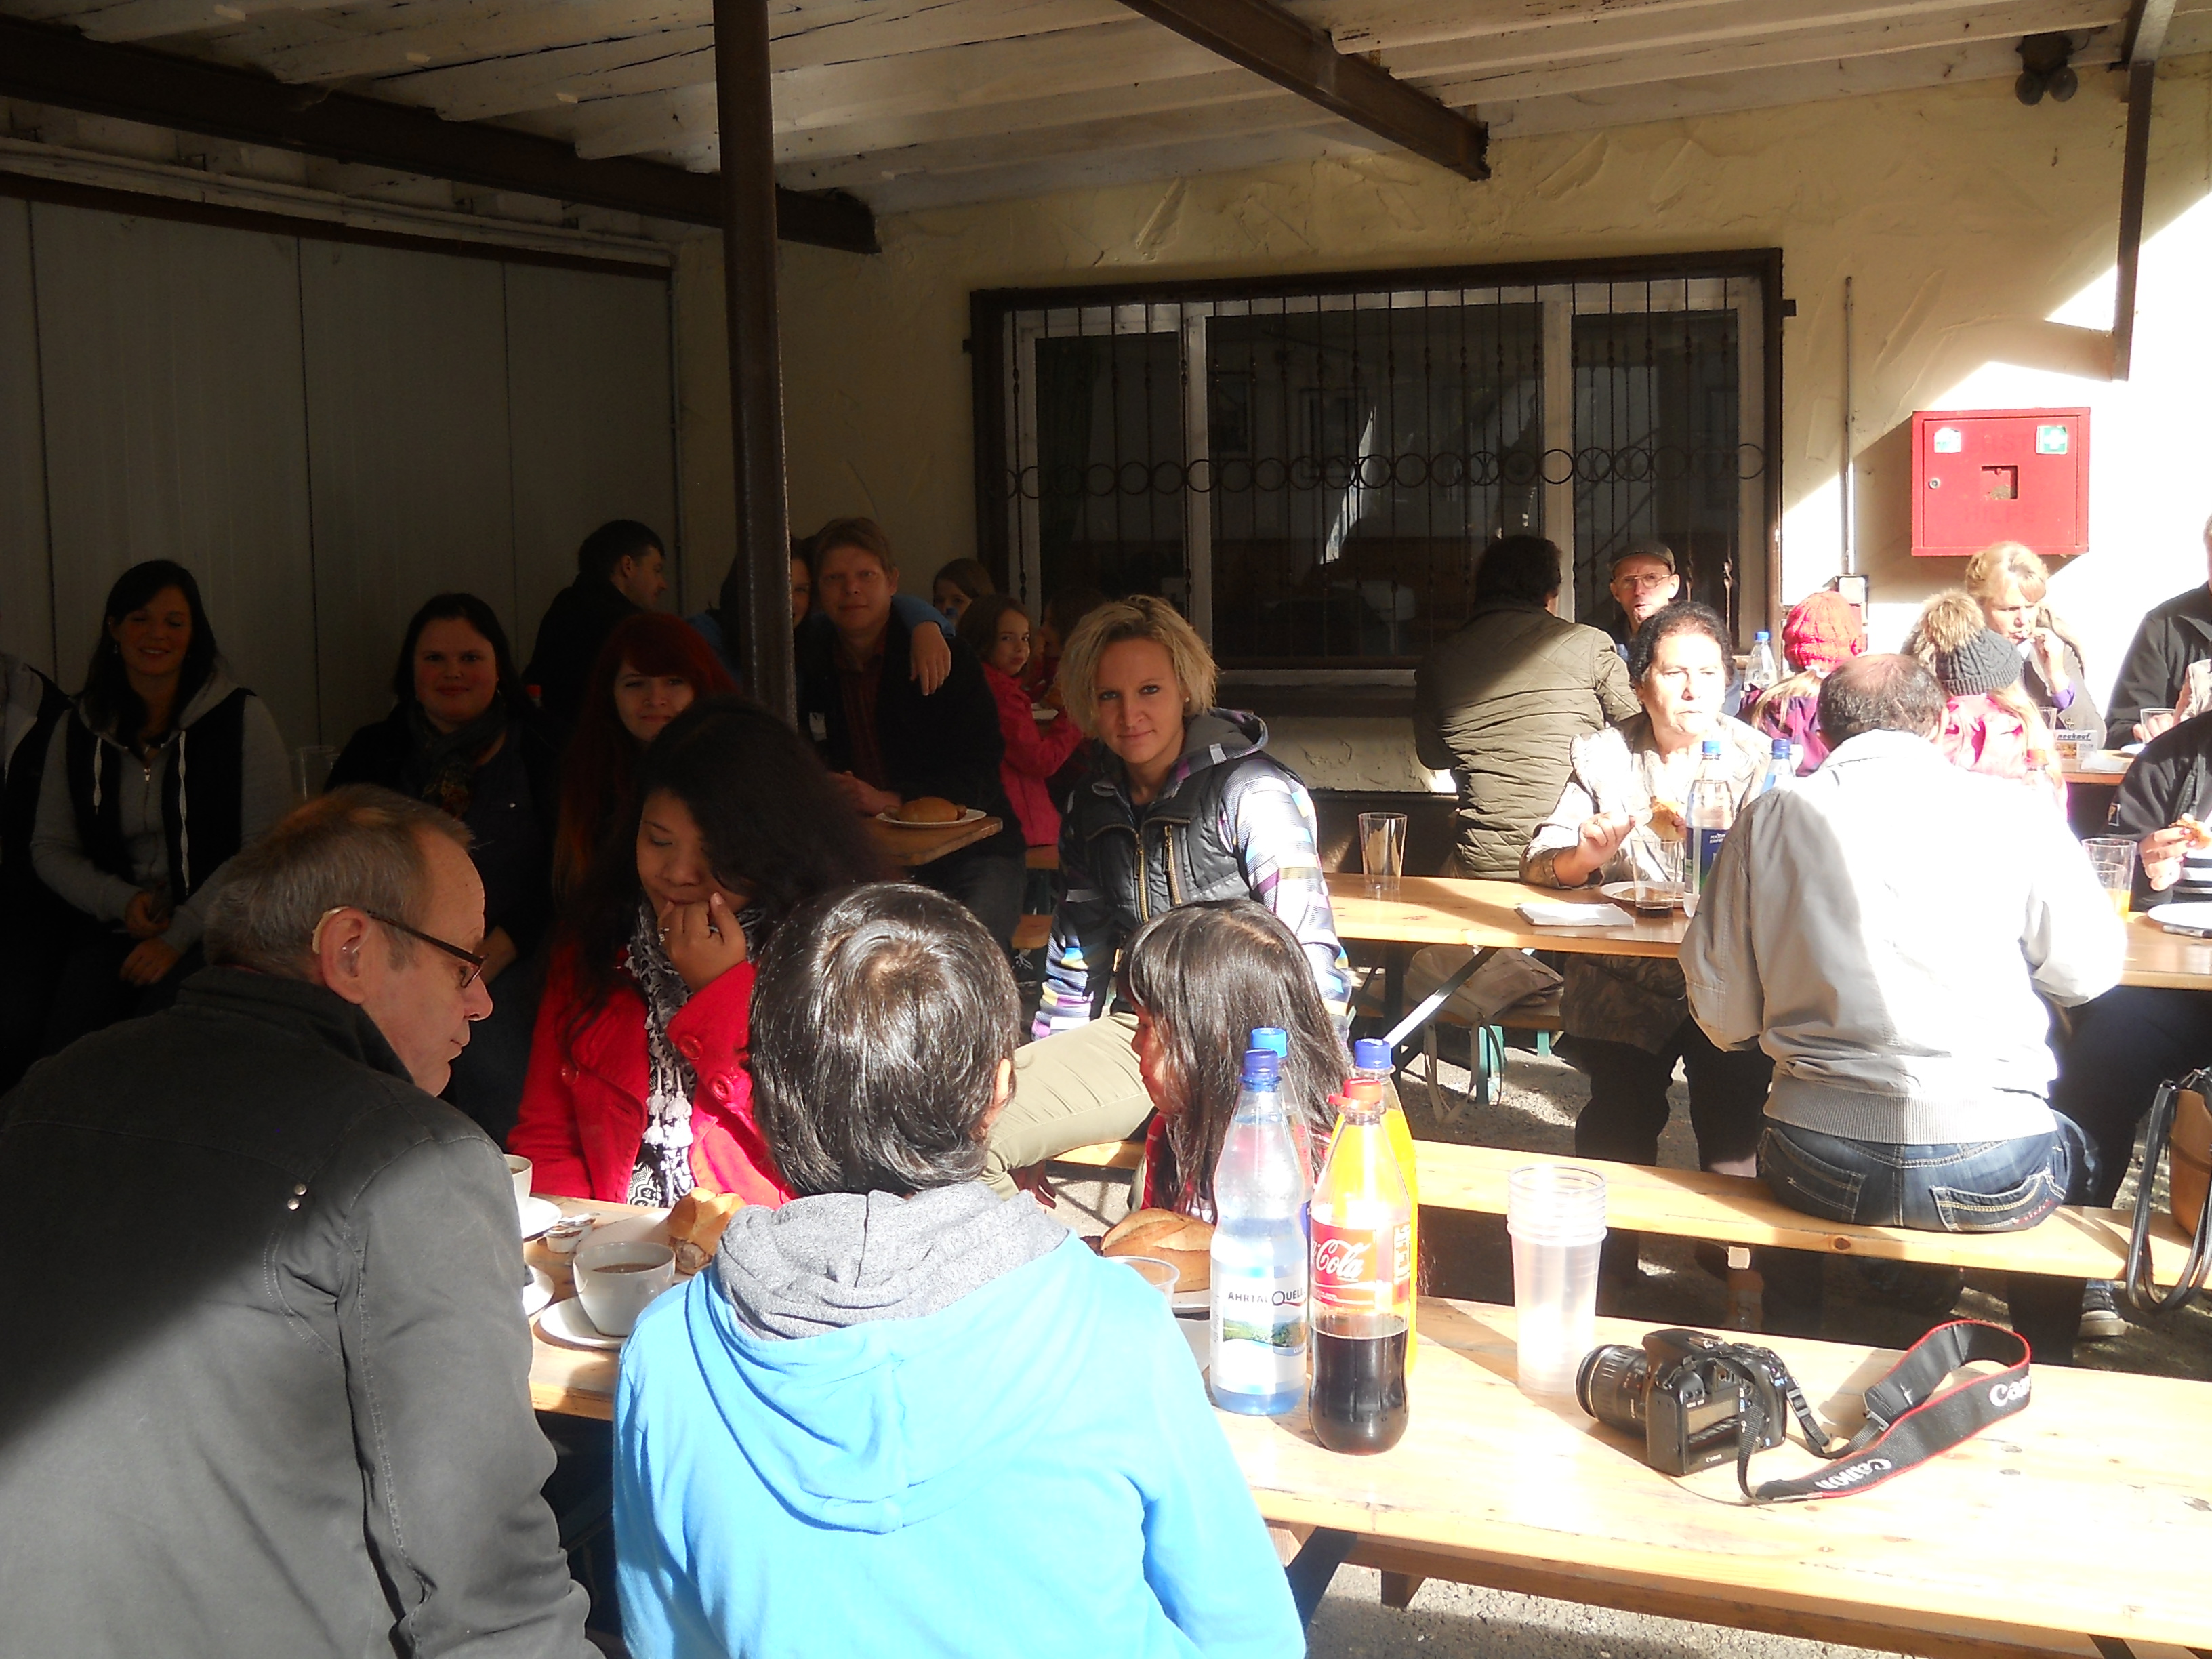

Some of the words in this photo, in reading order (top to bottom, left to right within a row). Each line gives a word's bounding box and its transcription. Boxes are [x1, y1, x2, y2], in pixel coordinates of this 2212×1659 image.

[1271, 1287, 1306, 1306] QUELL
[1989, 1376, 2031, 1407] Can
[1814, 1458, 1892, 1490] Canon
